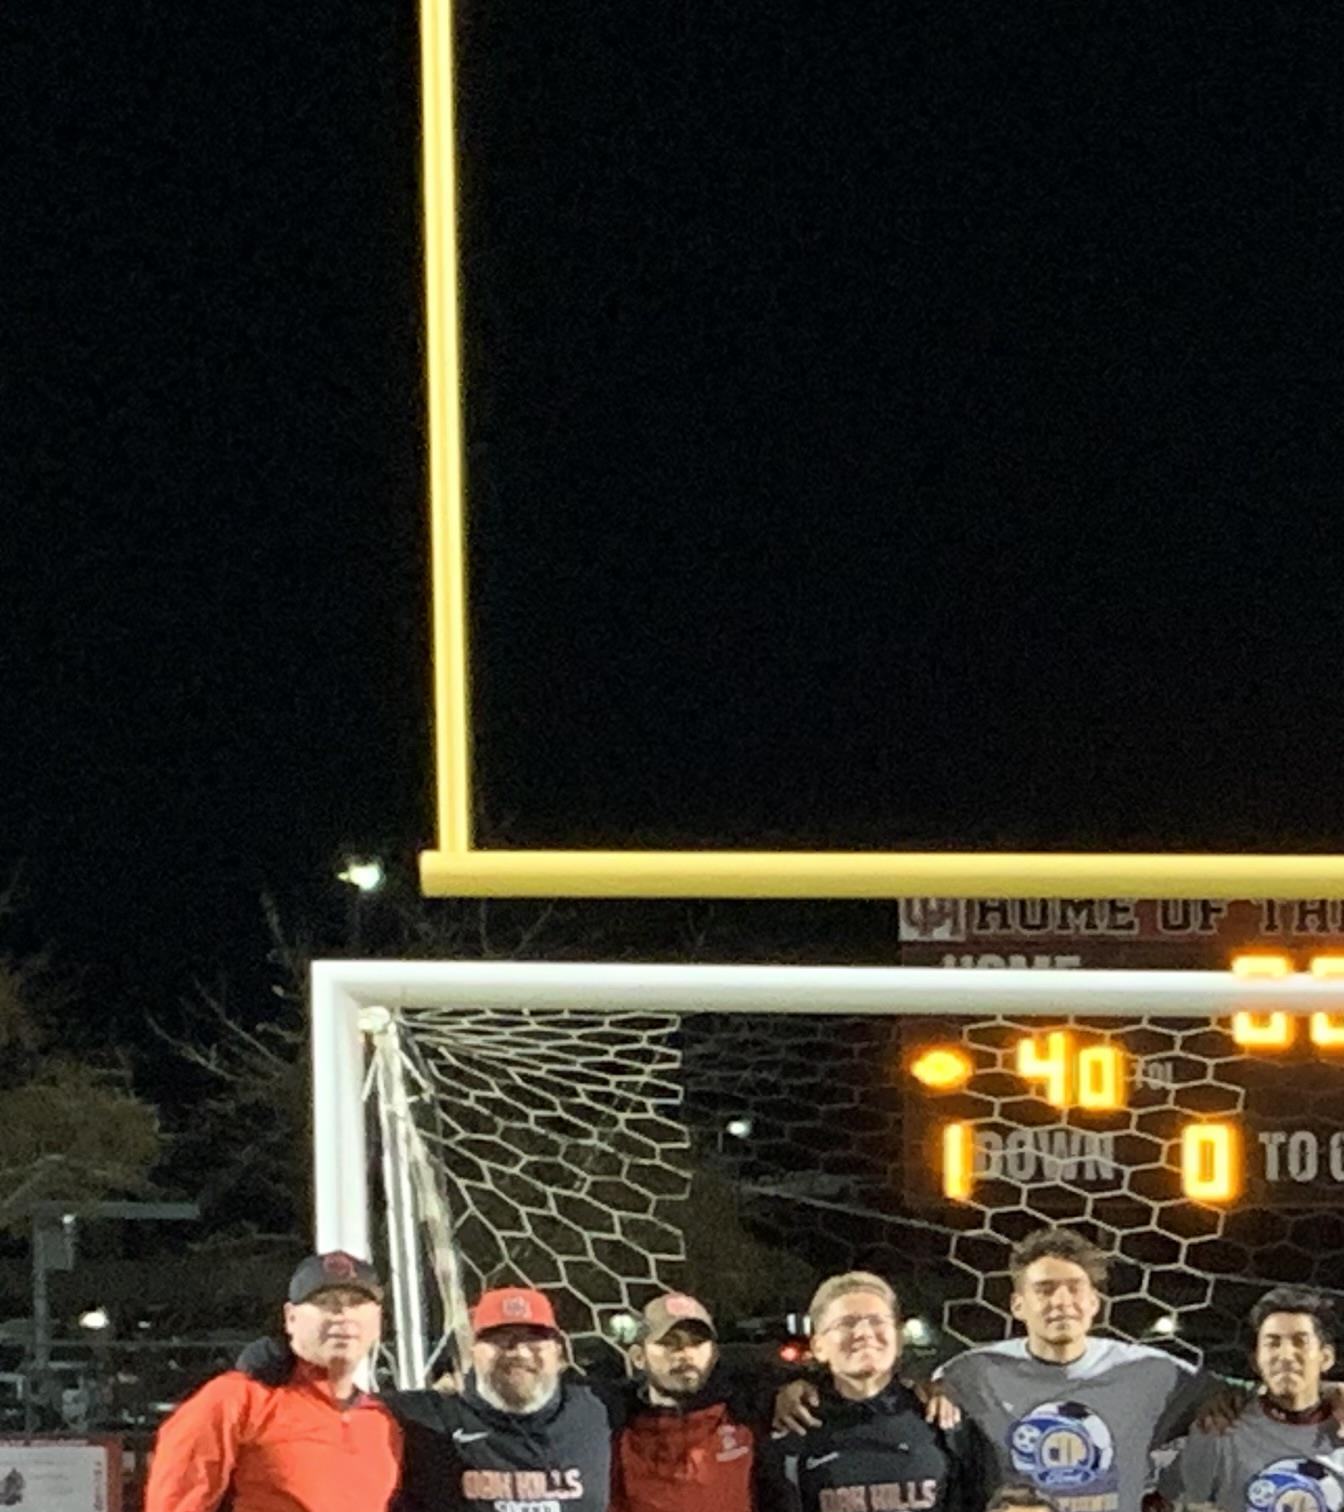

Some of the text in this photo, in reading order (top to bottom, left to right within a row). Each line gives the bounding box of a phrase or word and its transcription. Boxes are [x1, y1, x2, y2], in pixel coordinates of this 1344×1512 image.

[974, 899, 1139, 935] HOME
[1156, 899, 1228, 936] OF
[975, 1131, 1115, 1181] DOWN
[1182, 1124, 1236, 1200] 0
[1258, 1131, 1319, 1181] TO
